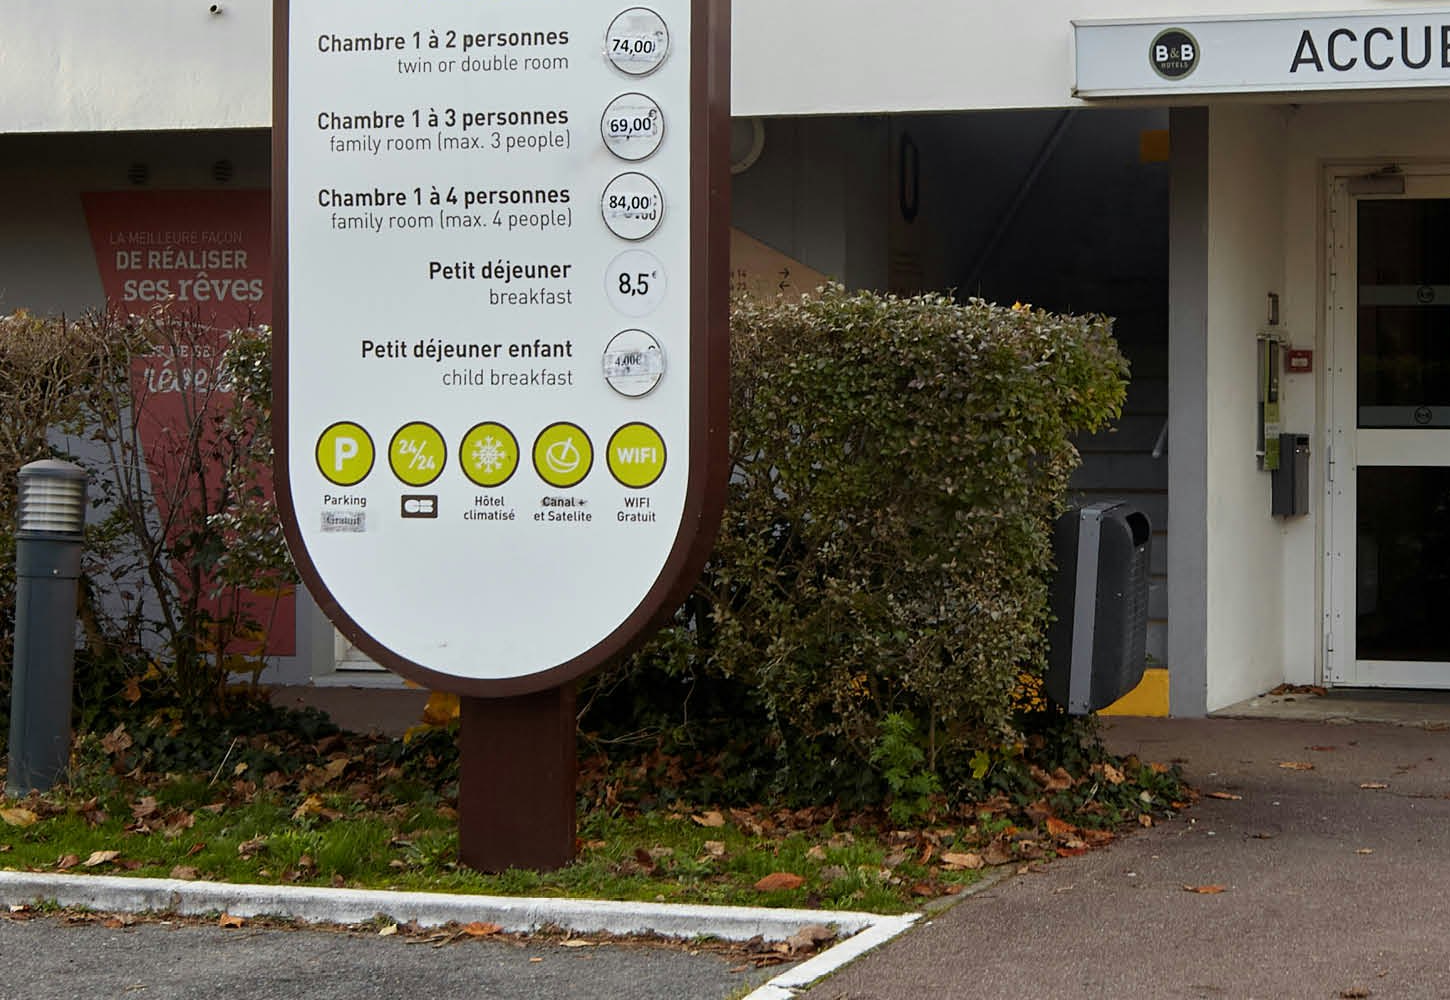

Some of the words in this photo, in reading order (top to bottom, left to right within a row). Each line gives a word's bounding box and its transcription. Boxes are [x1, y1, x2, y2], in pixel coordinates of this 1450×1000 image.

[318, 33, 406, 52] Chambre
[412, 31, 421, 49] 1
[428, 29, 439, 48] à
[445, 30, 457, 48] 2
[463, 30, 569, 52] personnes
[397, 57, 433, 73] twin
[438, 59, 456, 73] or
[461, 55, 519, 72] double
[524, 56, 569, 70] room
[317, 111, 405, 130] Chambre
[412, 109, 420, 128] 1
[428, 108, 439, 127] à
[444, 108, 456, 127] 3
[462, 109, 569, 131] personnes
[330, 135, 381, 155] family
[387, 136, 431, 150] room
[438, 131, 485, 151] (max.
[491, 131, 501, 149] 3
[506, 129, 570, 152] people)
[318, 188, 407, 207] Chambre
[413, 187, 422, 206] 1
[430, 186, 441, 205] à
[446, 187, 458, 205] 4
[464, 188, 570, 209] personnes
[331, 212, 383, 233] family
[389, 214, 433, 229] room
[440, 210, 487, 229] (max.
[492, 210, 502, 227] 4
[508, 208, 572, 231] people)
[116, 251, 142, 270] DE
[148, 246, 248, 270] RÉALISER
[429, 261, 475, 280] Petit
[481, 259, 572, 283] déjeuner
[124, 278, 169, 301] ses
[178, 272, 264, 301] rêves
[489, 288, 573, 305] breakfast
[362, 340, 408, 358] Petit
[413, 338, 502, 362] déjeuner
[508, 339, 573, 358] enfant
[442, 368, 485, 386] child
[490, 368, 573, 386] breakfast
[335, 437, 359, 471] P
[617, 447, 656, 464] WIFI
[324, 494, 367, 508] Parking
[474, 495, 505, 507] Hôtel
[542, 496, 576, 507] Canal
[625, 497, 650, 508] WIFI
[463, 508, 515, 521] climatisé
[534, 512, 545, 522] et
[548, 510, 592, 522] Satelite
[617, 510, 656, 522] Gratuit
